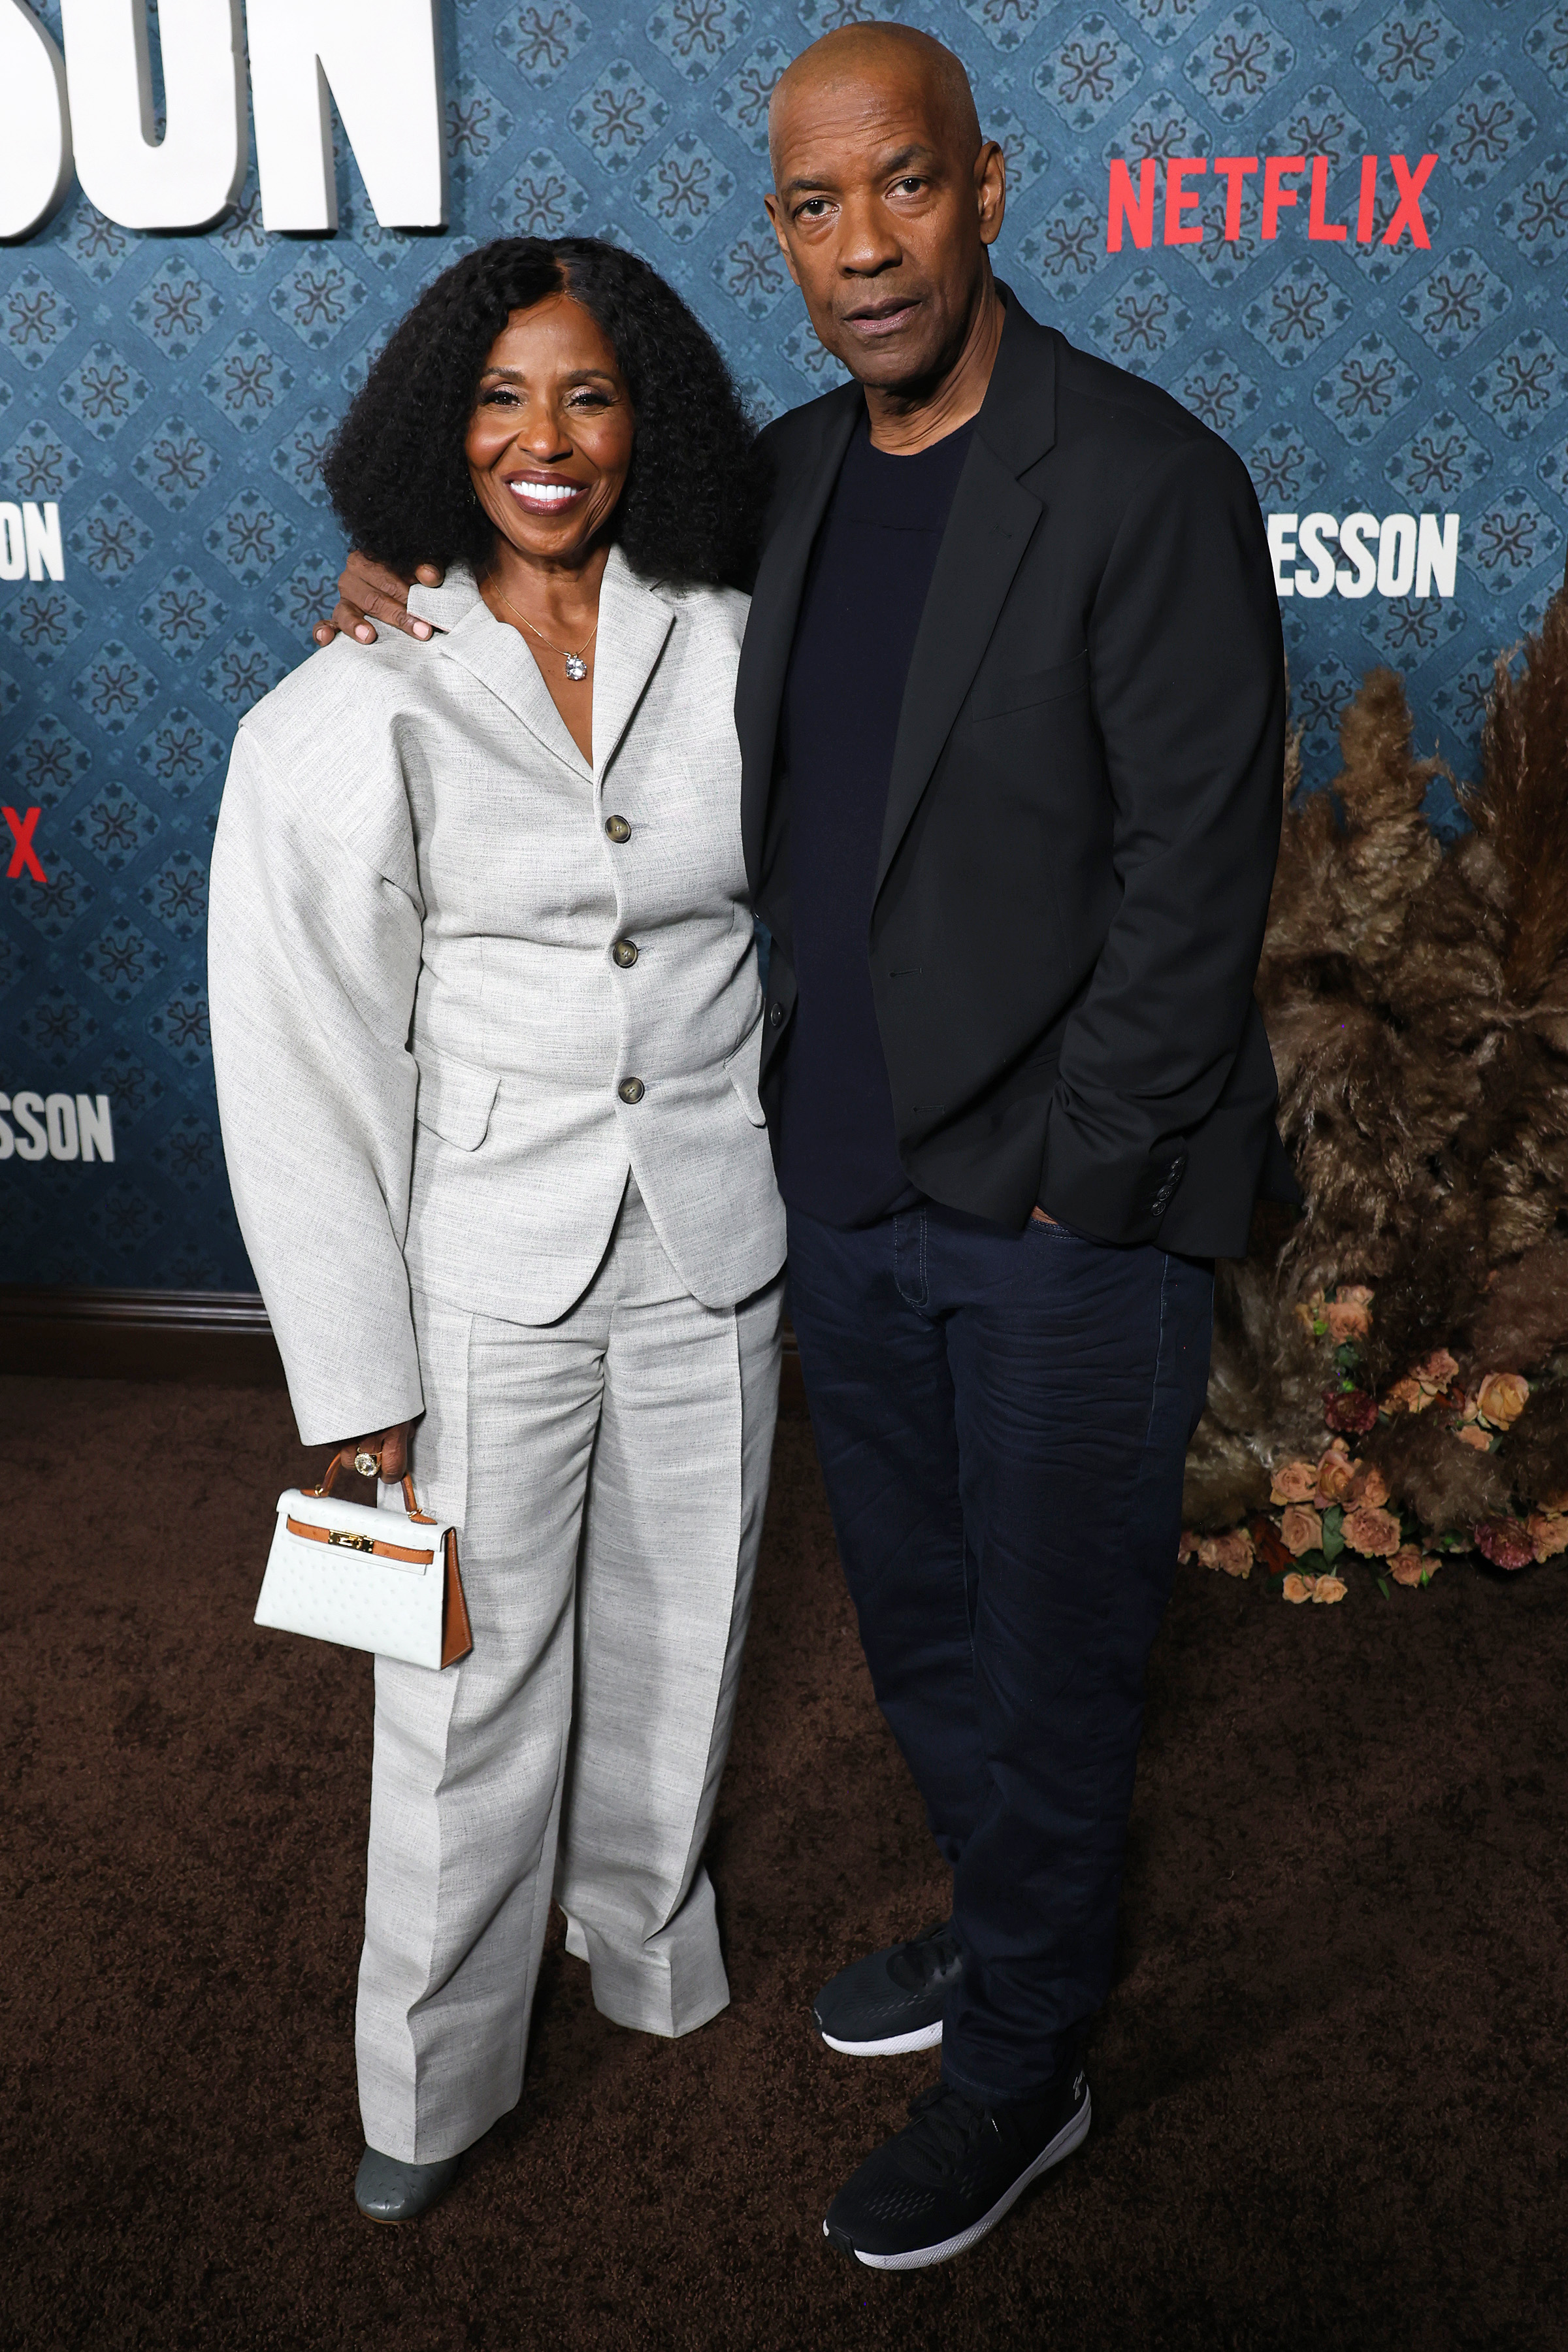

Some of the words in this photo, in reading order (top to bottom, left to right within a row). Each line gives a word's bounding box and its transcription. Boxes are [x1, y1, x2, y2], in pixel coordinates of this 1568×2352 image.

[1106, 154, 1439, 253] NETFLIX
[1267, 512, 1460, 598] ESSON
[1, 806, 48, 883] X
